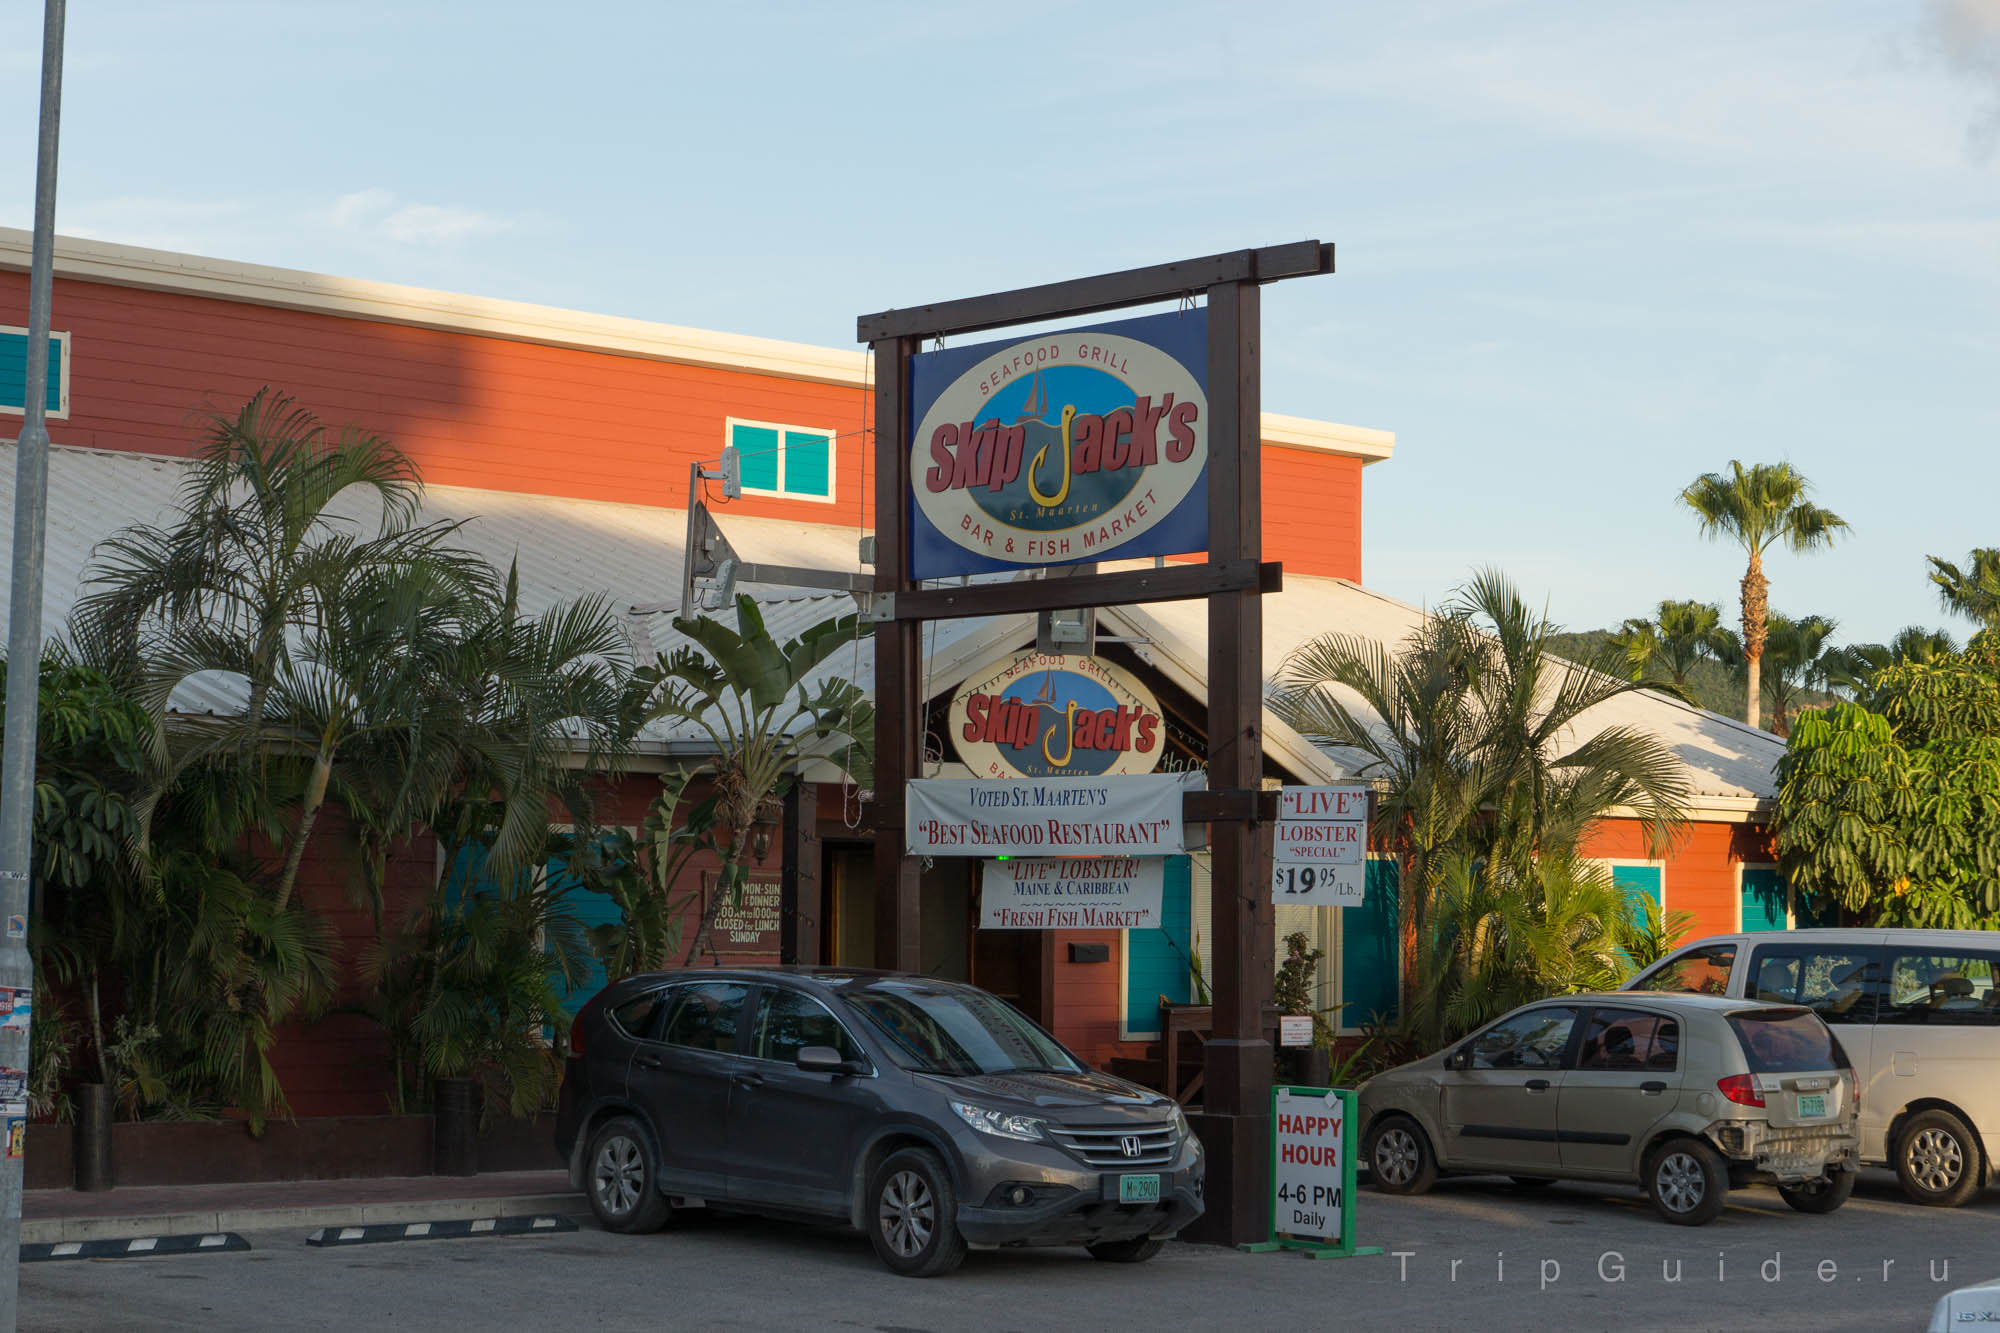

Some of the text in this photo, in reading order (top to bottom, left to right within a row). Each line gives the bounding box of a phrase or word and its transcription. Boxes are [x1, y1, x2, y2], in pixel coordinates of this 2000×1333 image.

[980, 344, 1129, 395] SEAFOOD GRILL
[960, 489, 1158, 556] BAR & FISH MARKET
[1009, 503, 1099, 521] St. Maarten
[969, 786, 1108, 808] VOTED ST. MAARTEN'S
[1283, 792, 1363, 815] "LIVE"
[918, 819, 1170, 845] "BEST SEAFOOD RESTAURANT"
[1280, 825, 1358, 842] LOBSTER
[1289, 847, 1346, 858] "SPECIAL"
[1059, 859, 1141, 880] LOBSTER!
[1013, 881, 1130, 896] MAINE & CARIBBEAN
[749, 896, 780, 907] DINNER
[714, 918, 744, 930] CLOSED
[754, 919, 780, 932] LUNCH
[993, 907, 1149, 927] "FRESH FISH MARKET"
[729, 931, 761, 943] SUNDAY
[1279, 1114, 1342, 1138] HAPPY
[1281, 1143, 1337, 1168] HOUR
[1278, 1182, 1342, 1208] 4-6 PM
[1293, 1209, 1326, 1230] Daily
